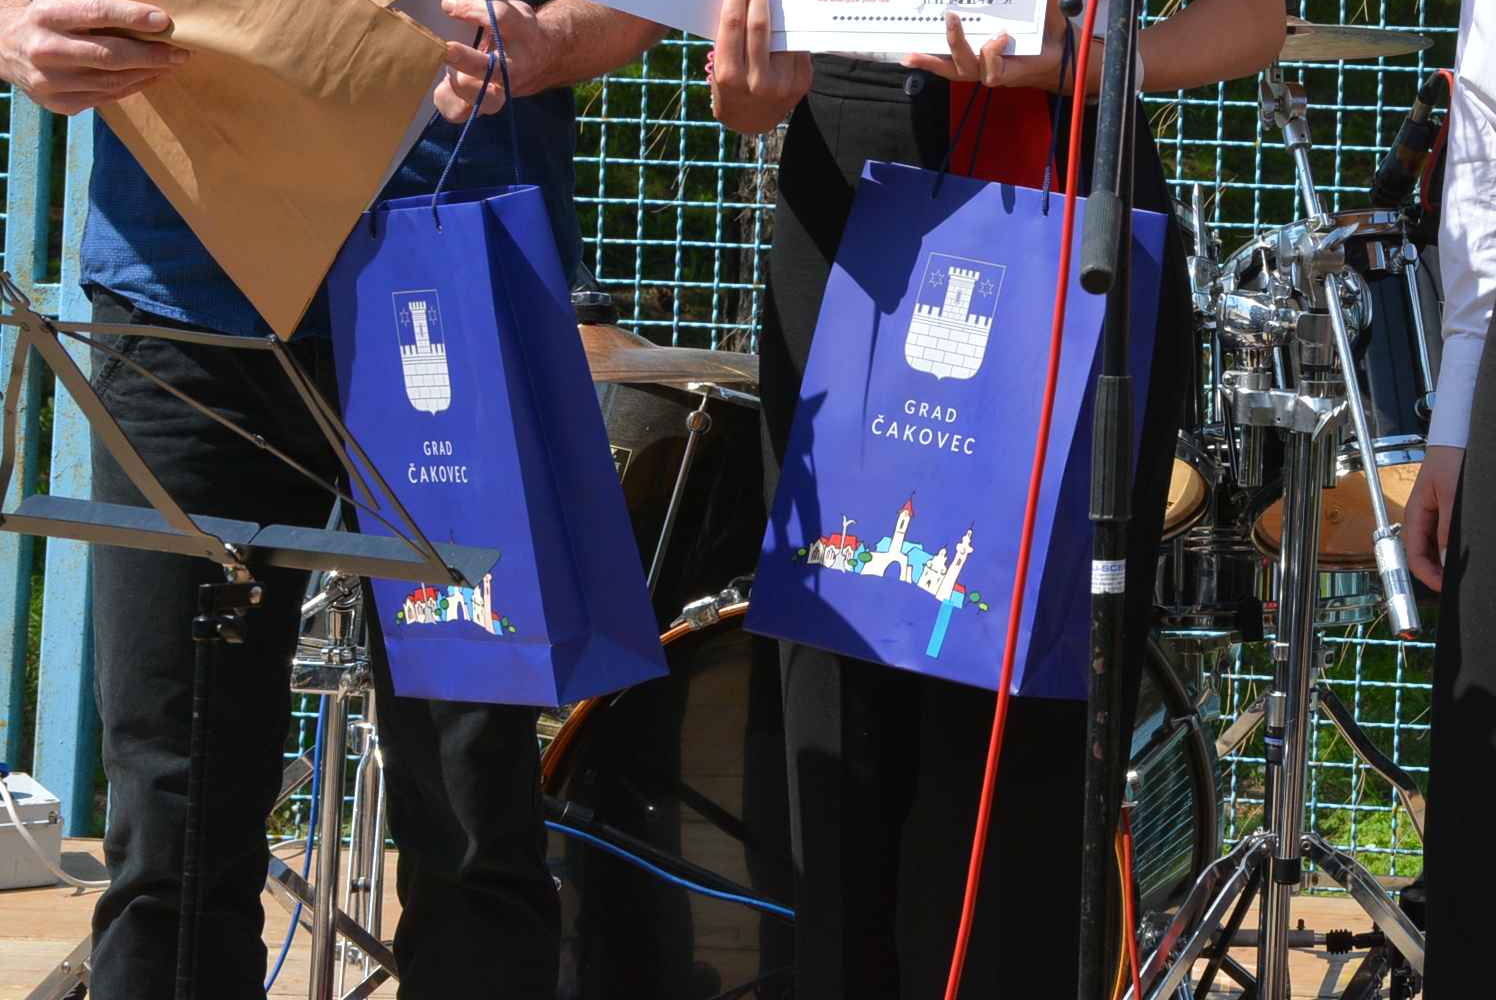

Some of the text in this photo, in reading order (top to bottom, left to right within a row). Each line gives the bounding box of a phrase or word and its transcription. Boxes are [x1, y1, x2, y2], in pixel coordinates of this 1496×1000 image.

[904, 399, 957, 423] GRAD
[871, 414, 976, 455] ČAKOVEC
[423, 440, 453, 456] GRAD
[408, 462, 468, 484] ČAKOVEC
